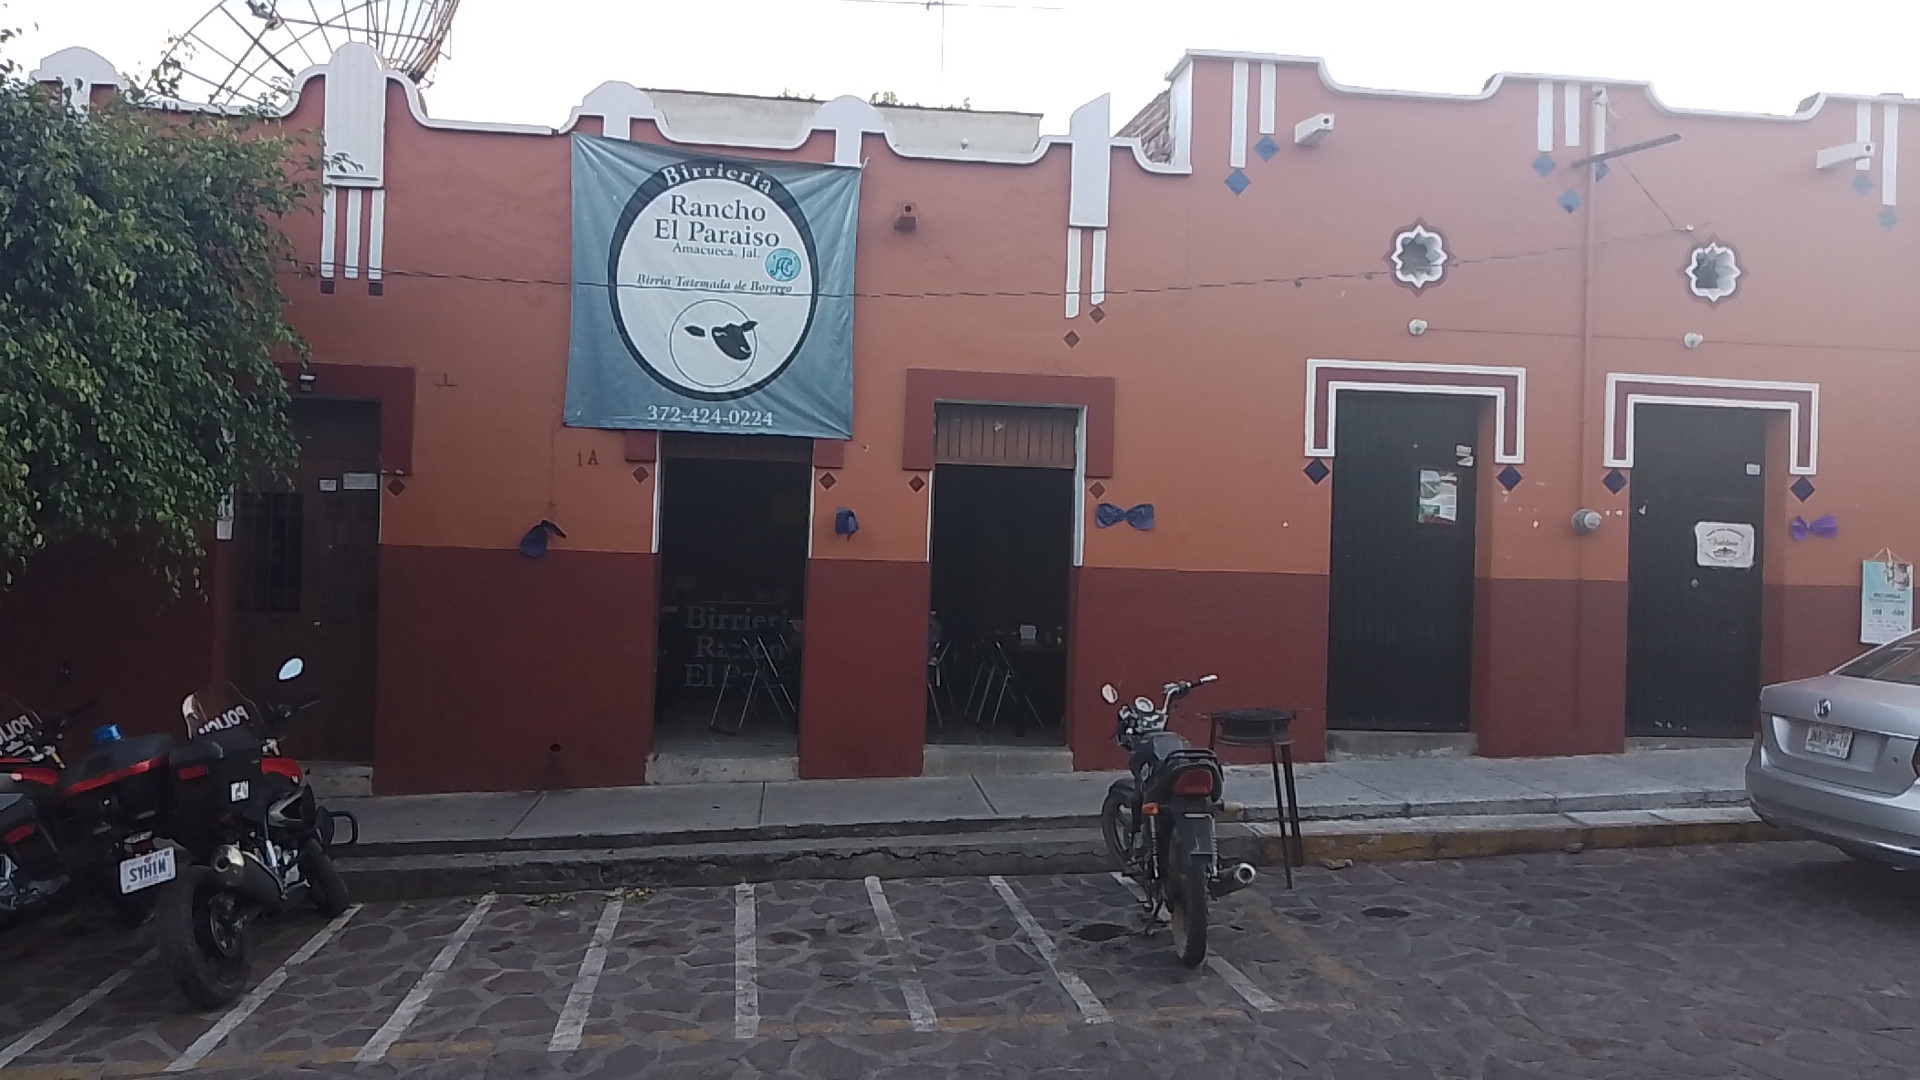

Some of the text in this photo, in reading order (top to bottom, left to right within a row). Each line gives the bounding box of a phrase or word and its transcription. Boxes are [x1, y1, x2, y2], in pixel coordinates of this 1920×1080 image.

[669, 194, 766, 222] Rancho
[654, 219, 780, 247] El Paraiso
[637, 273, 793, 295] Birria Tatemada de Borrego
[647, 406, 774, 427] 372-424-0224
[684, 605, 790, 630] Birrieri
